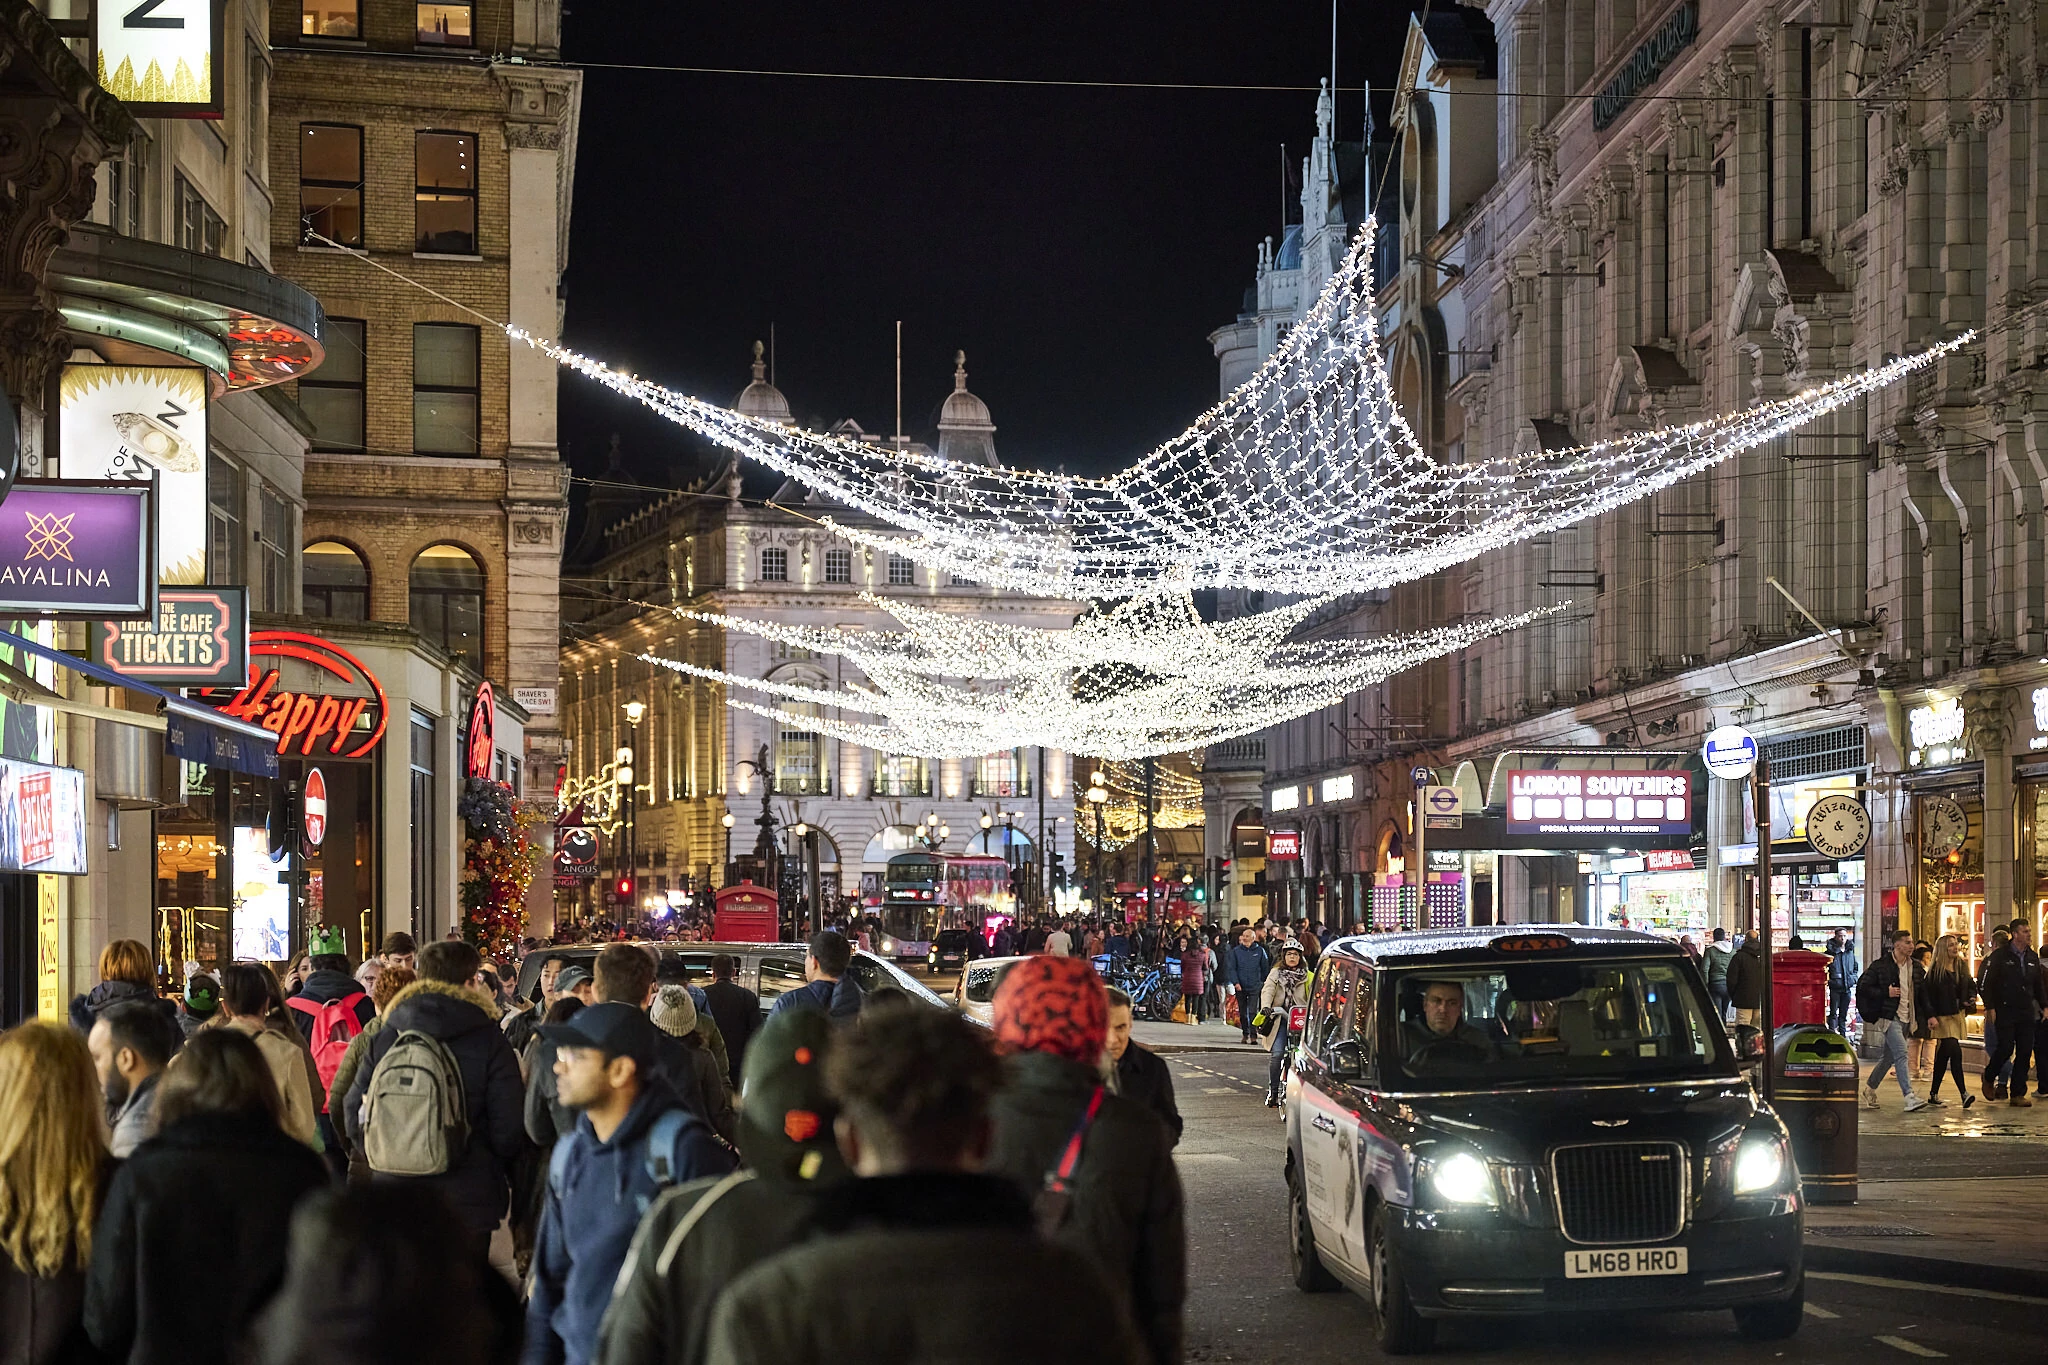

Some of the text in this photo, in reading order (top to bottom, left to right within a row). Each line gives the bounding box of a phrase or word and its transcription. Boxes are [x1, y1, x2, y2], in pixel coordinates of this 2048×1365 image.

[161, 603, 175, 613] THE
[121, 614, 213, 633] THEARE CAFE
[121, 633, 213, 664] TICKETS
[517, 690, 547, 698] SHAVER'S
[201, 663, 367, 756] Happy
[517, 698, 551, 706] PLACE SW1
[1512, 775, 1687, 796] LONDON SOUVENIRS
[21, 793, 52, 846] GREASE
[1813, 801, 1865, 825] Wizards
[1834, 820, 1845, 831] &
[1273, 839, 1295, 847] FIVE
[1814, 831, 1865, 857] Wonders
[1272, 847, 1297, 855] GUYS
[563, 865, 598, 873] ANGUS
[1506, 939, 1563, 950] TAXI
[1575, 1250, 1678, 1273] LM68 HRO
